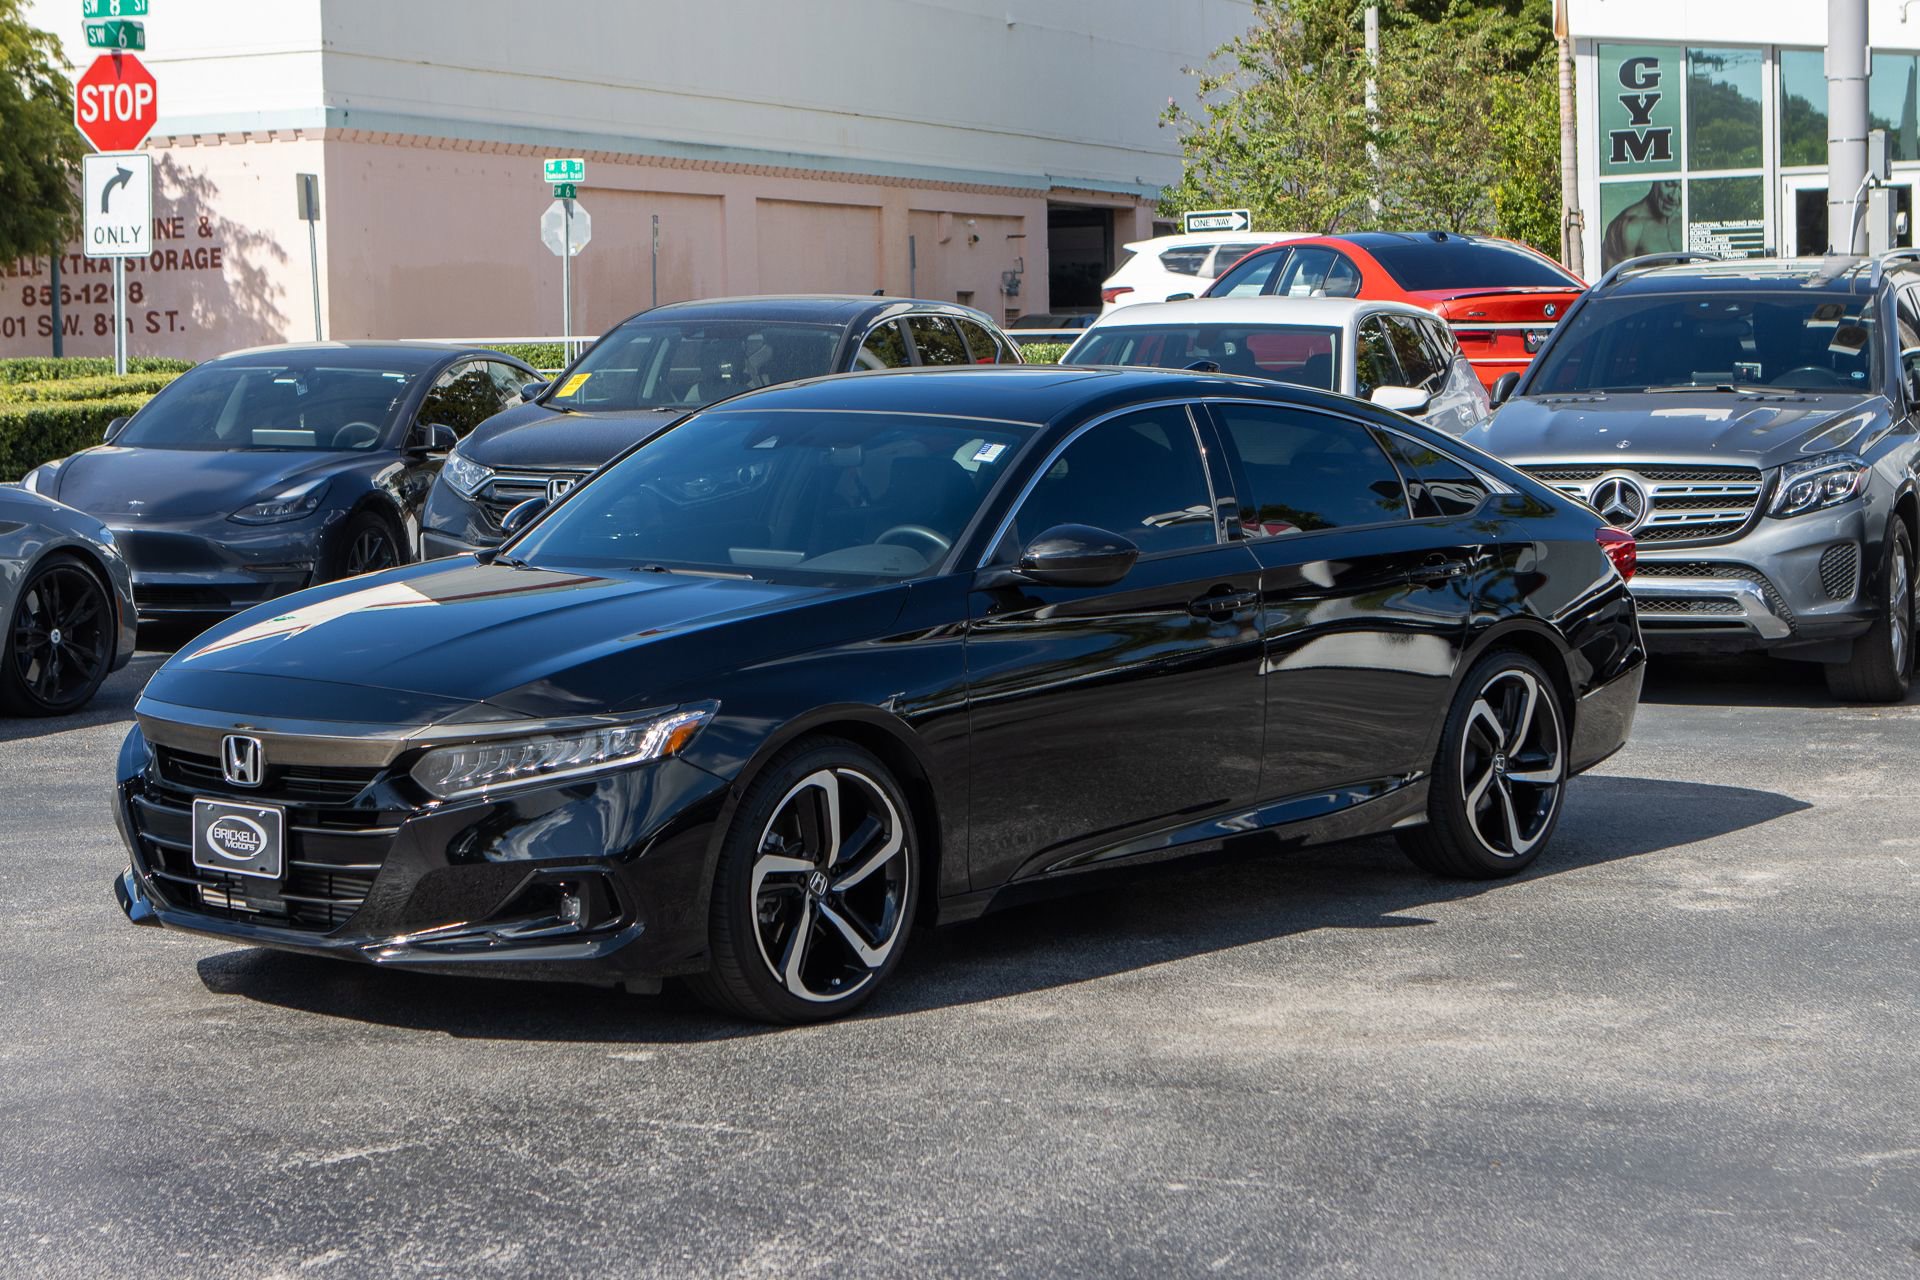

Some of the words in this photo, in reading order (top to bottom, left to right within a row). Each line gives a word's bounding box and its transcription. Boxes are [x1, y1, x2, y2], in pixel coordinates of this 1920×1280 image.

[84, 0, 99, 14] SW
[109, 0, 120, 16] 8
[88, 27, 105, 43] SW
[118, 26, 127, 48] 6
[80, 83, 153, 123] STOP
[1609, 57, 1673, 164] GYM
[566, 185, 571, 197] 6
[198, 216, 213, 238] &
[1193, 219, 1211, 228] ONE
[94, 225, 141, 244] ONLY
[125, 248, 222, 272] STORAGE
[0, 316, 26, 337] 01
[214, 827, 259, 844] BRICKELL
[224, 839, 256, 851] Motors
